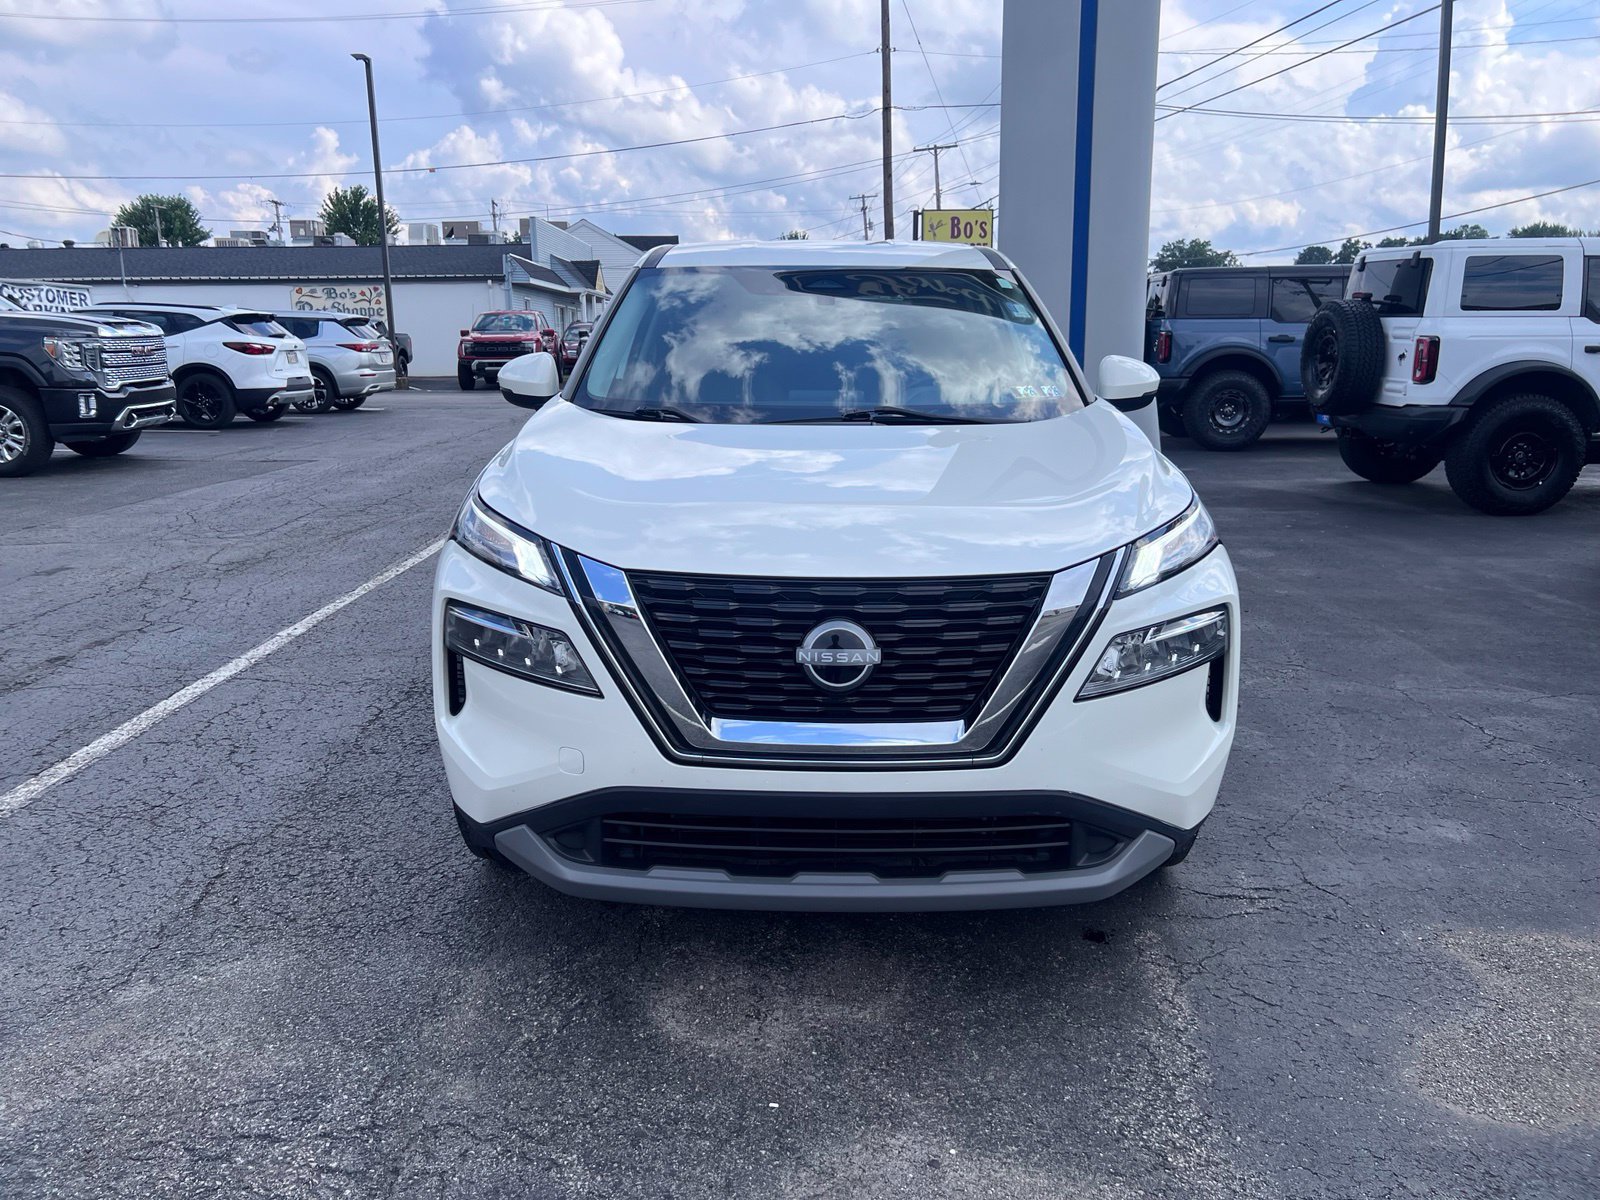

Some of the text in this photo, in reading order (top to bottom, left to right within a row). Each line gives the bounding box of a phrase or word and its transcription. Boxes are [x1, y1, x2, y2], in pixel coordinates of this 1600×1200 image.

[950, 216, 988, 239] Bo's
[322, 287, 358, 300] Bo's
[798, 652, 879, 663] NISSAN
